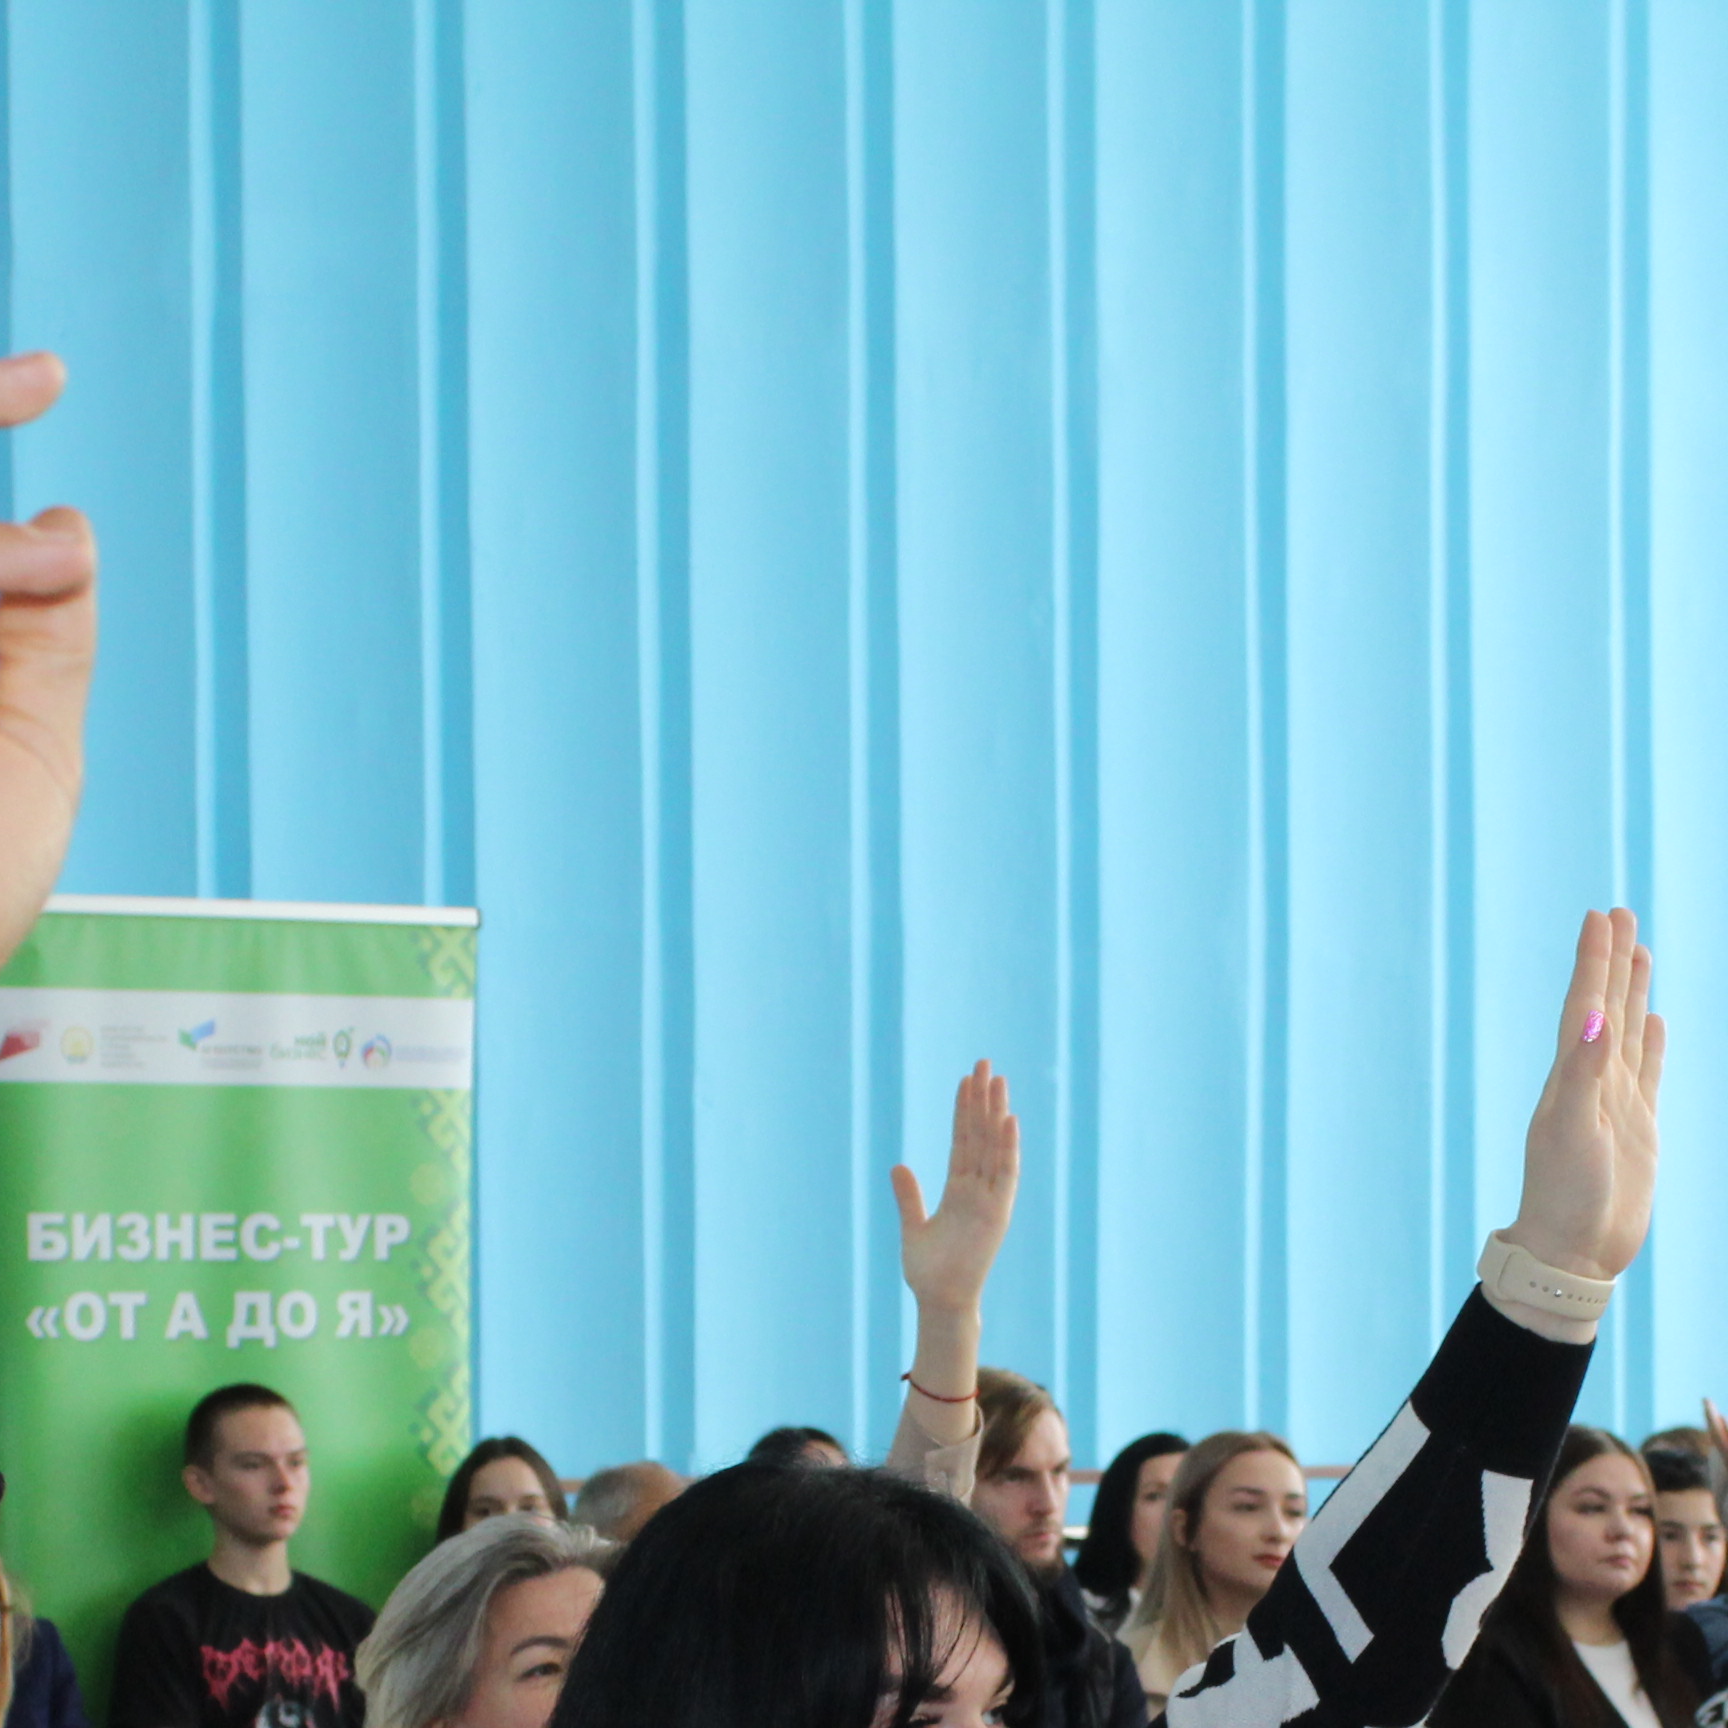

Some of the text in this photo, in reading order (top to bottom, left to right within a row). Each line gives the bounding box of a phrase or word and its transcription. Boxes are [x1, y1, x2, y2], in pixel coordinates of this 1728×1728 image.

[26, 1211, 411, 1263] БИЗНЕС-ТУР
[25, 1291, 410, 1349] «ОТ А ДО Я»
